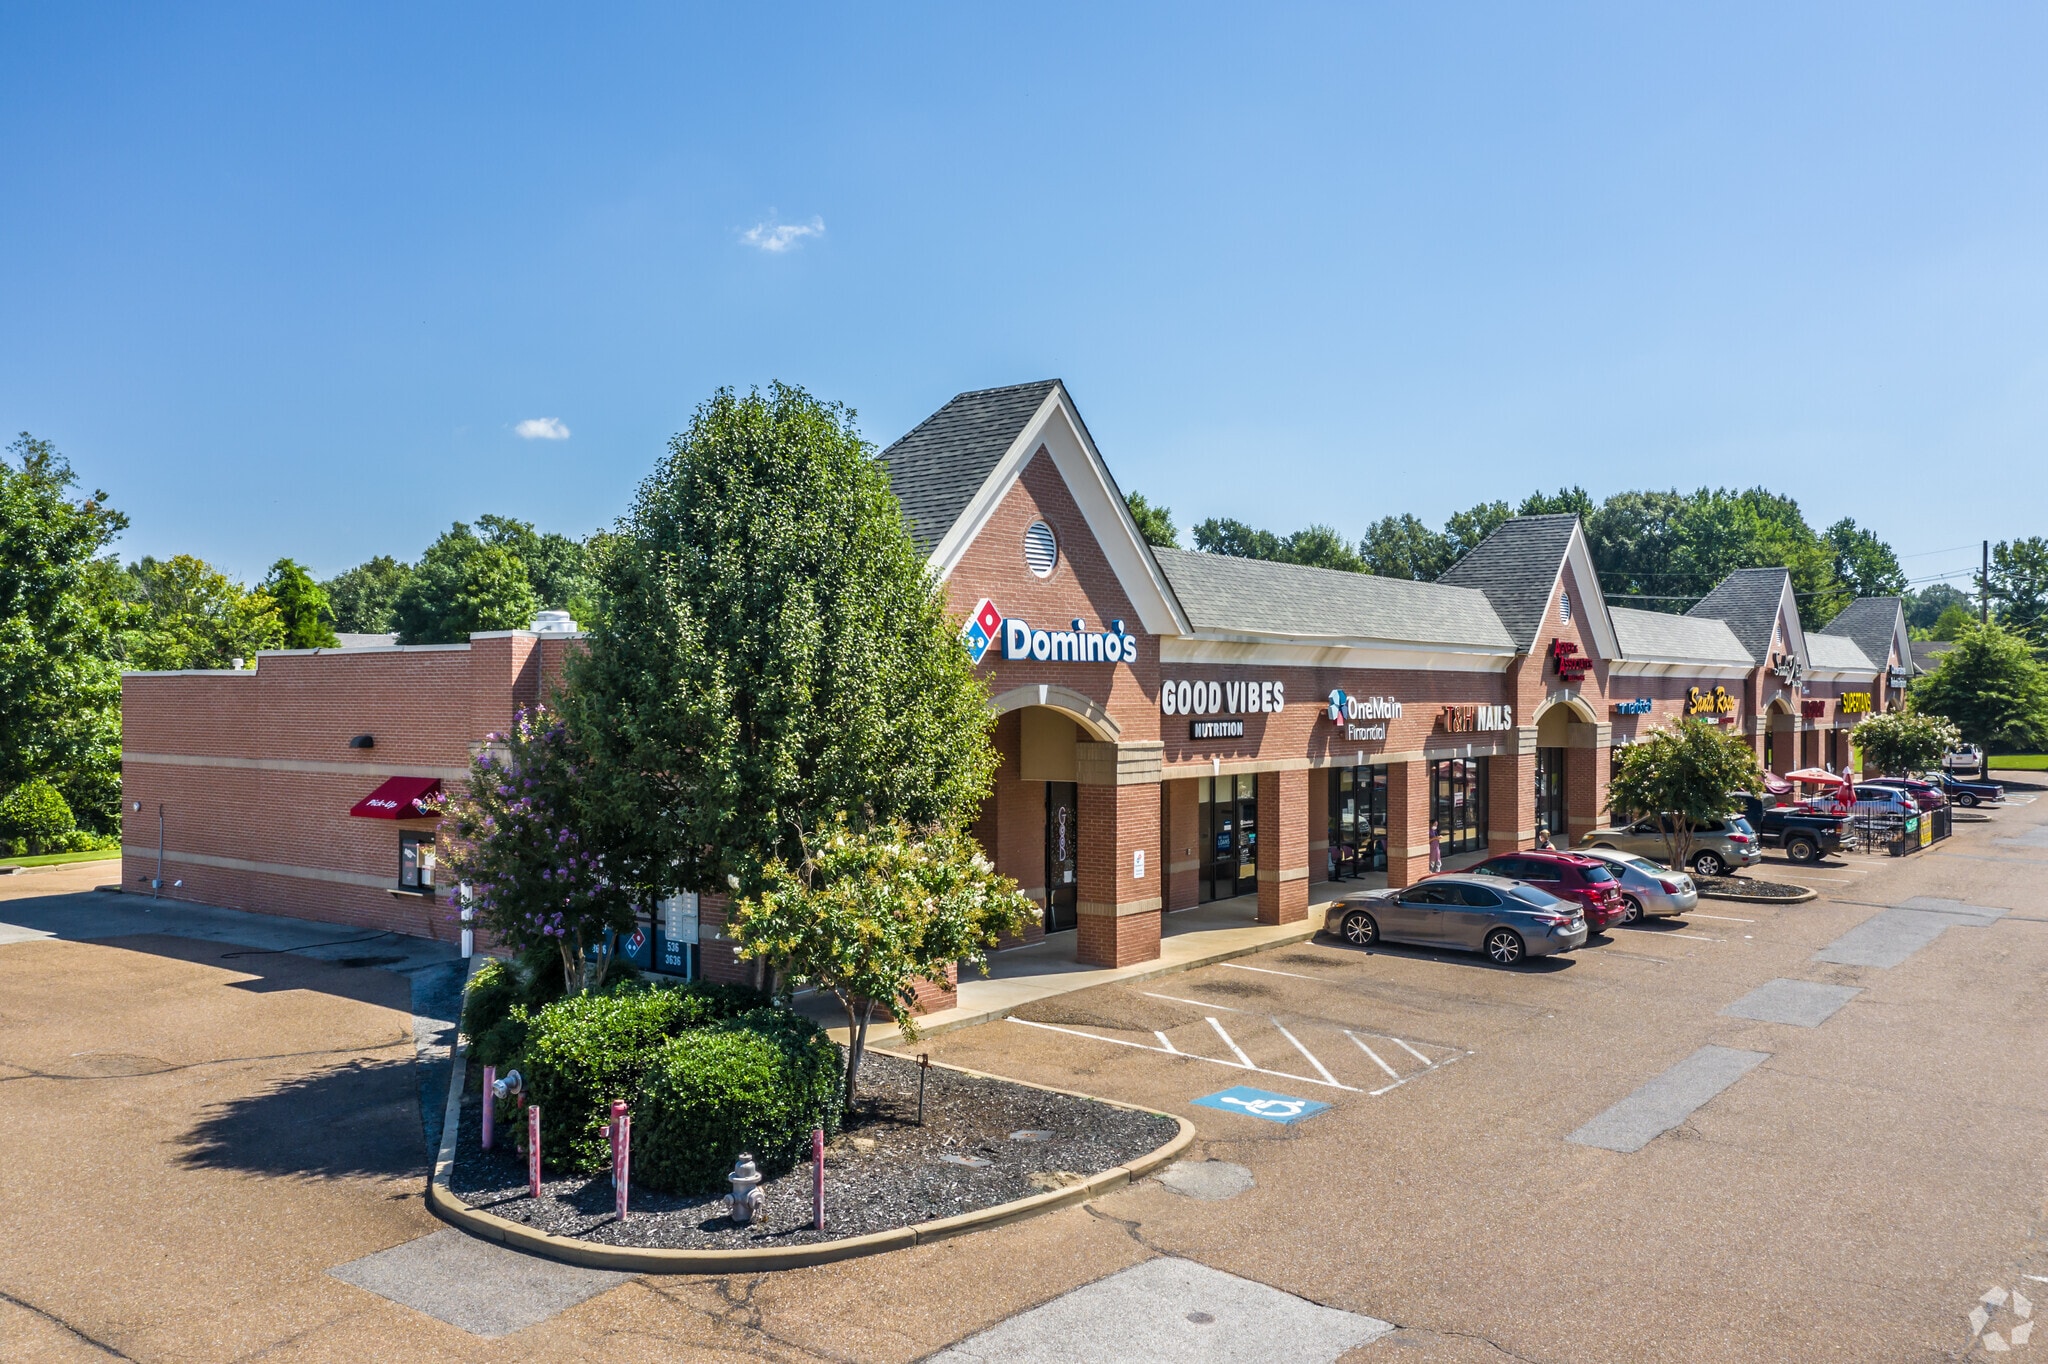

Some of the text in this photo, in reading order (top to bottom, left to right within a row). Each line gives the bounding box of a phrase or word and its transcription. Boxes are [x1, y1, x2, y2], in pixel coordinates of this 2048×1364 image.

[1003, 618, 1137, 663] Domino's
[1162, 680, 1285, 715] GOOD VIBES
[1347, 696, 1402, 719] OneMain
[1689, 686, 1714, 714] Santa
[1194, 722, 1243, 738] NUTRITION
[1446, 705, 1512, 732] T&H NAILS
[1348, 722, 1386, 741] Financial
[366, 799, 398, 809] Pick-Up
[665, 954, 682, 966] 3636
